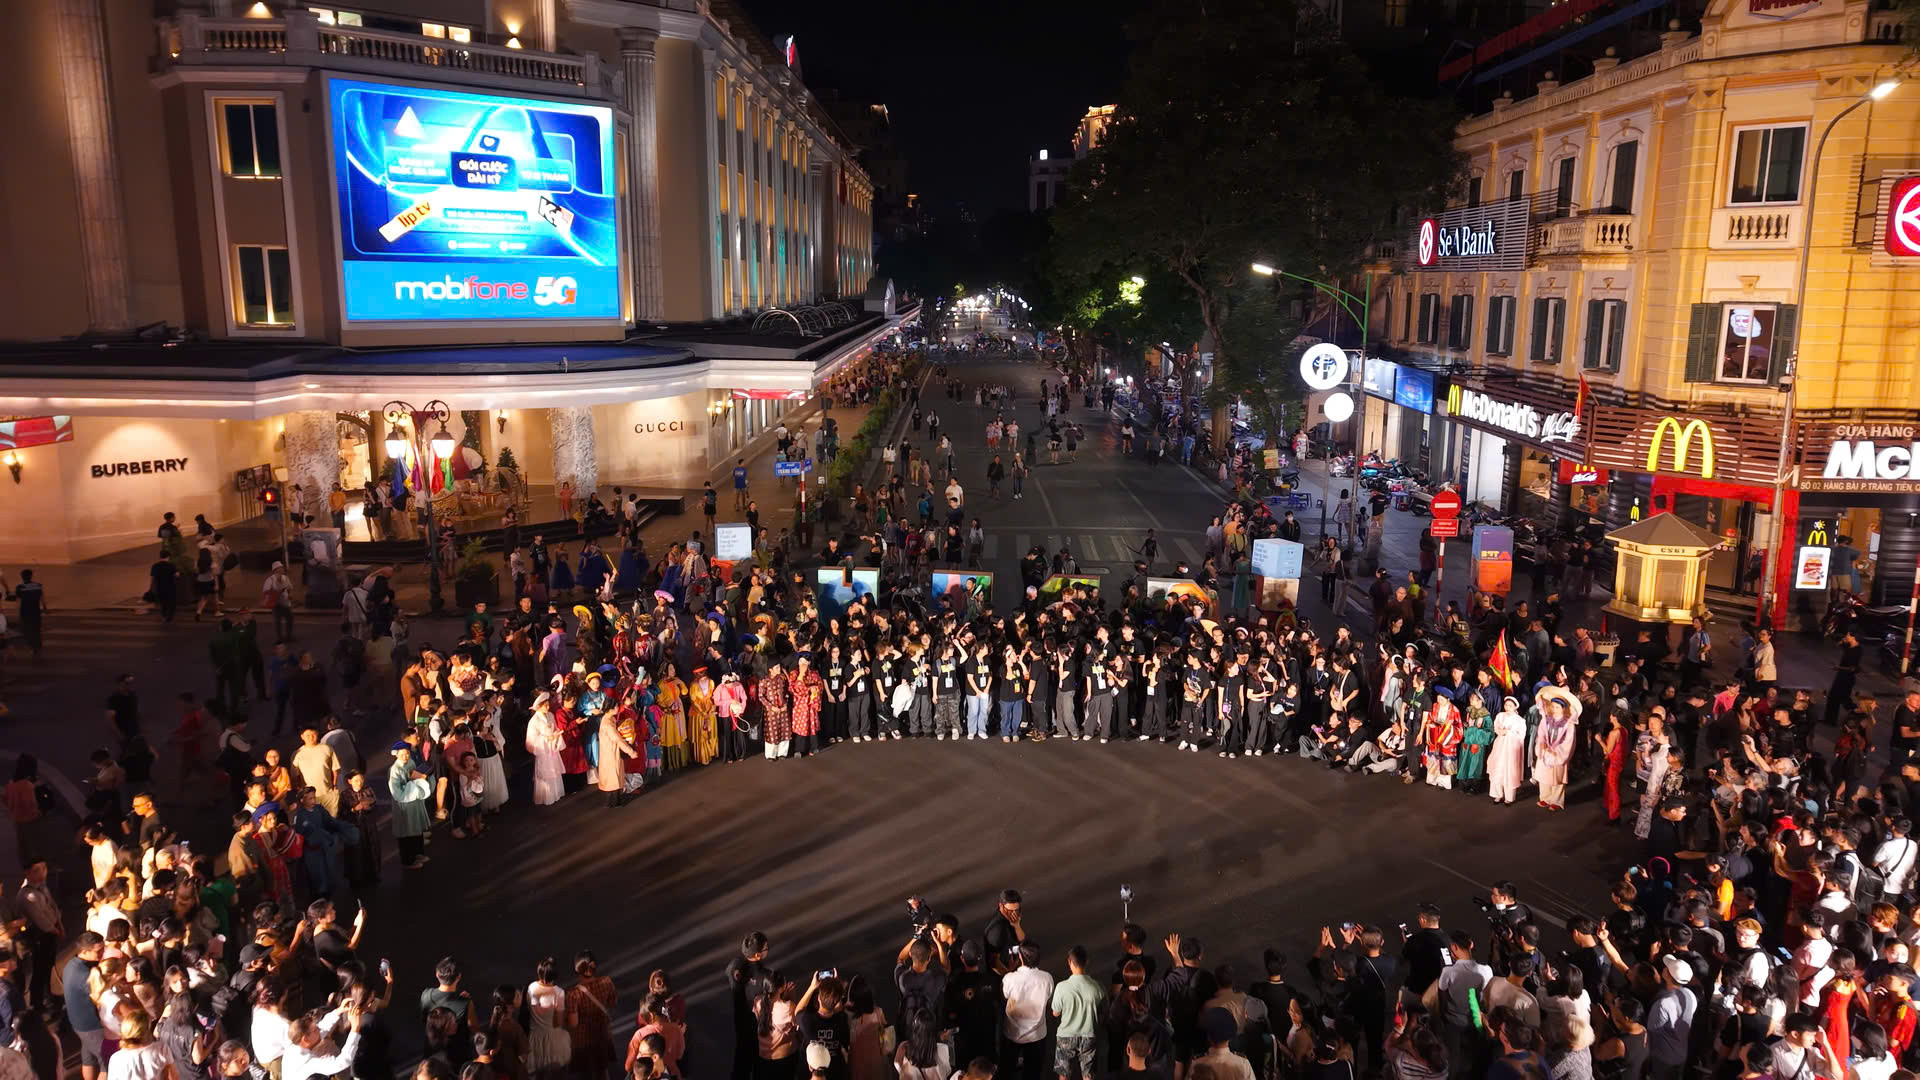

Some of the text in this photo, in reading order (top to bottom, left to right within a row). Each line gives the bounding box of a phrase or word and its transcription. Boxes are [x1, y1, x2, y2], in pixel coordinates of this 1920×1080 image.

[395, 274, 577, 306] mobifone 5G
[634, 420, 684, 434] GUCCI
[1461, 389, 1538, 438] McDonald's
[1836, 424, 1914, 437] CỬA HÀNG
[91, 457, 189, 479] BURBERRY
[1823, 440, 1920, 480] Mc
